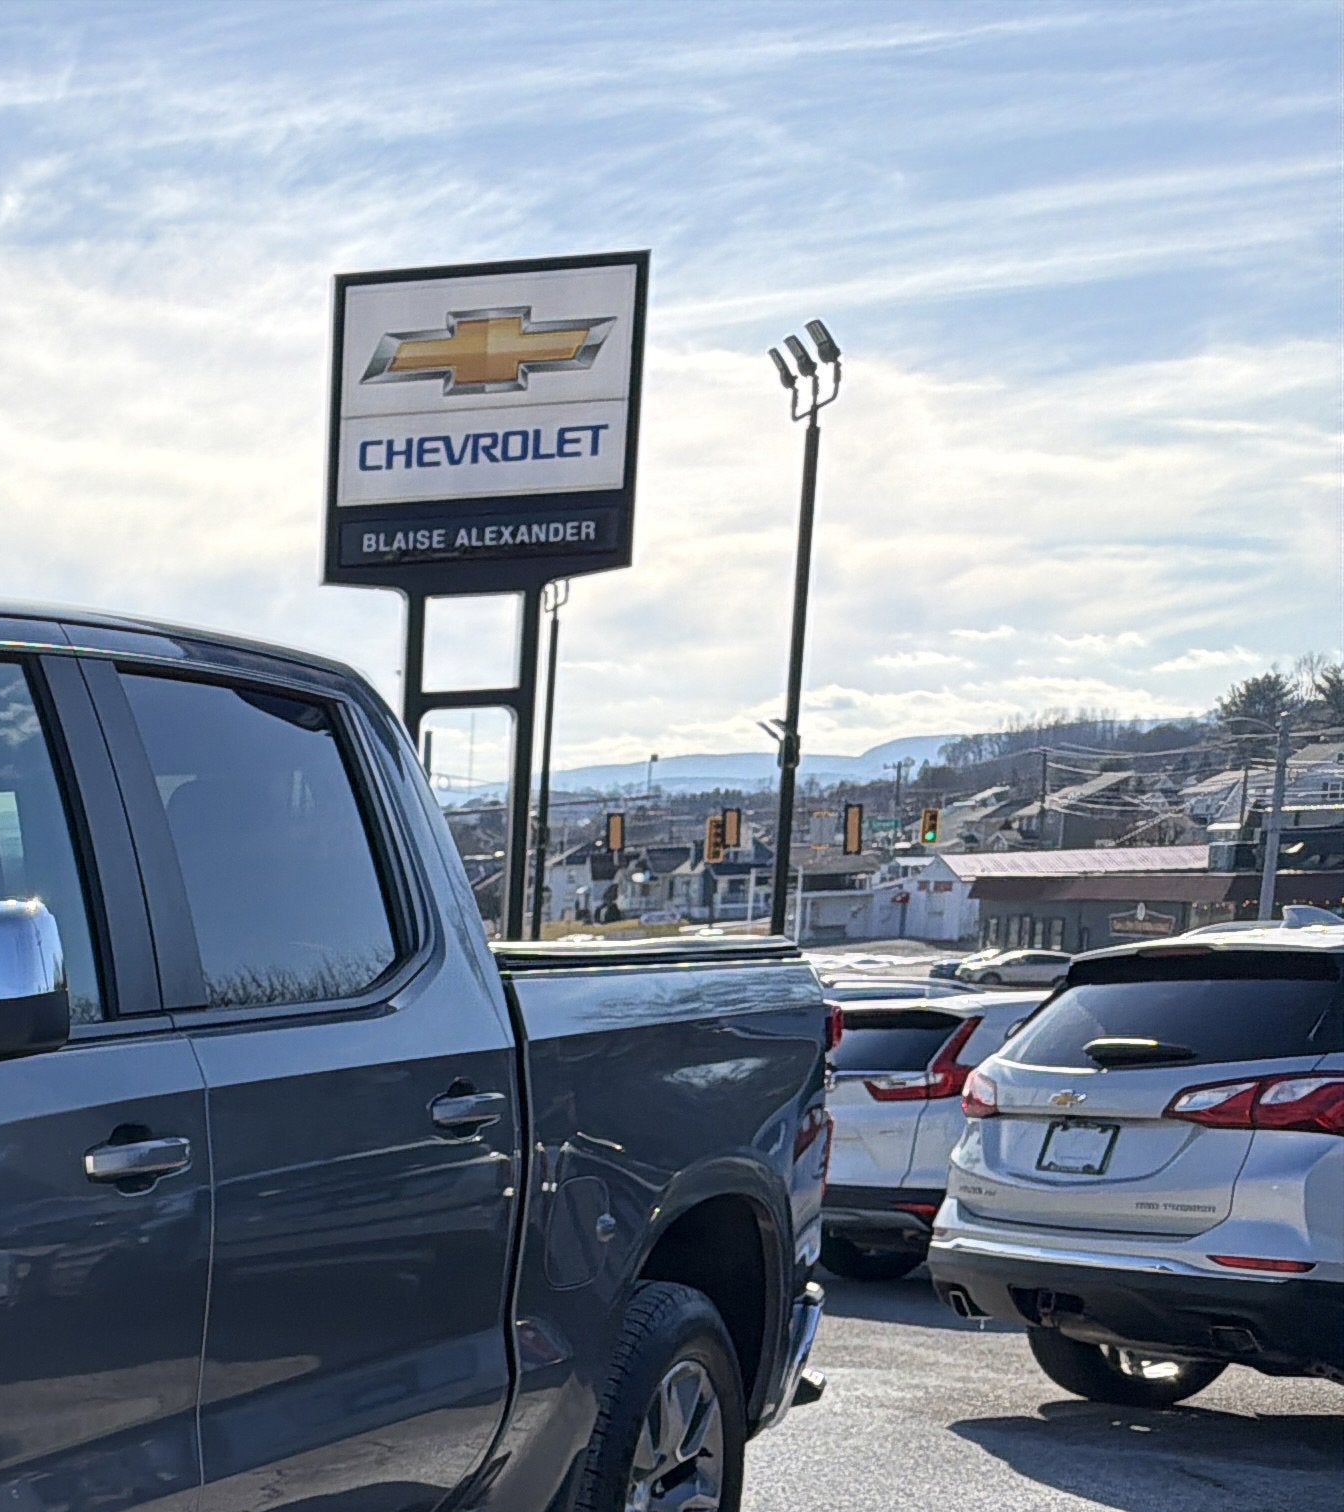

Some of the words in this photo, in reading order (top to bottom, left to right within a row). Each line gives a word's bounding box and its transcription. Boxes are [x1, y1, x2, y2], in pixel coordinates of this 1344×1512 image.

[358, 423, 610, 472] CHEVROLET
[362, 528, 446, 553] BLAISE
[454, 520, 597, 546] ALEXANDER
